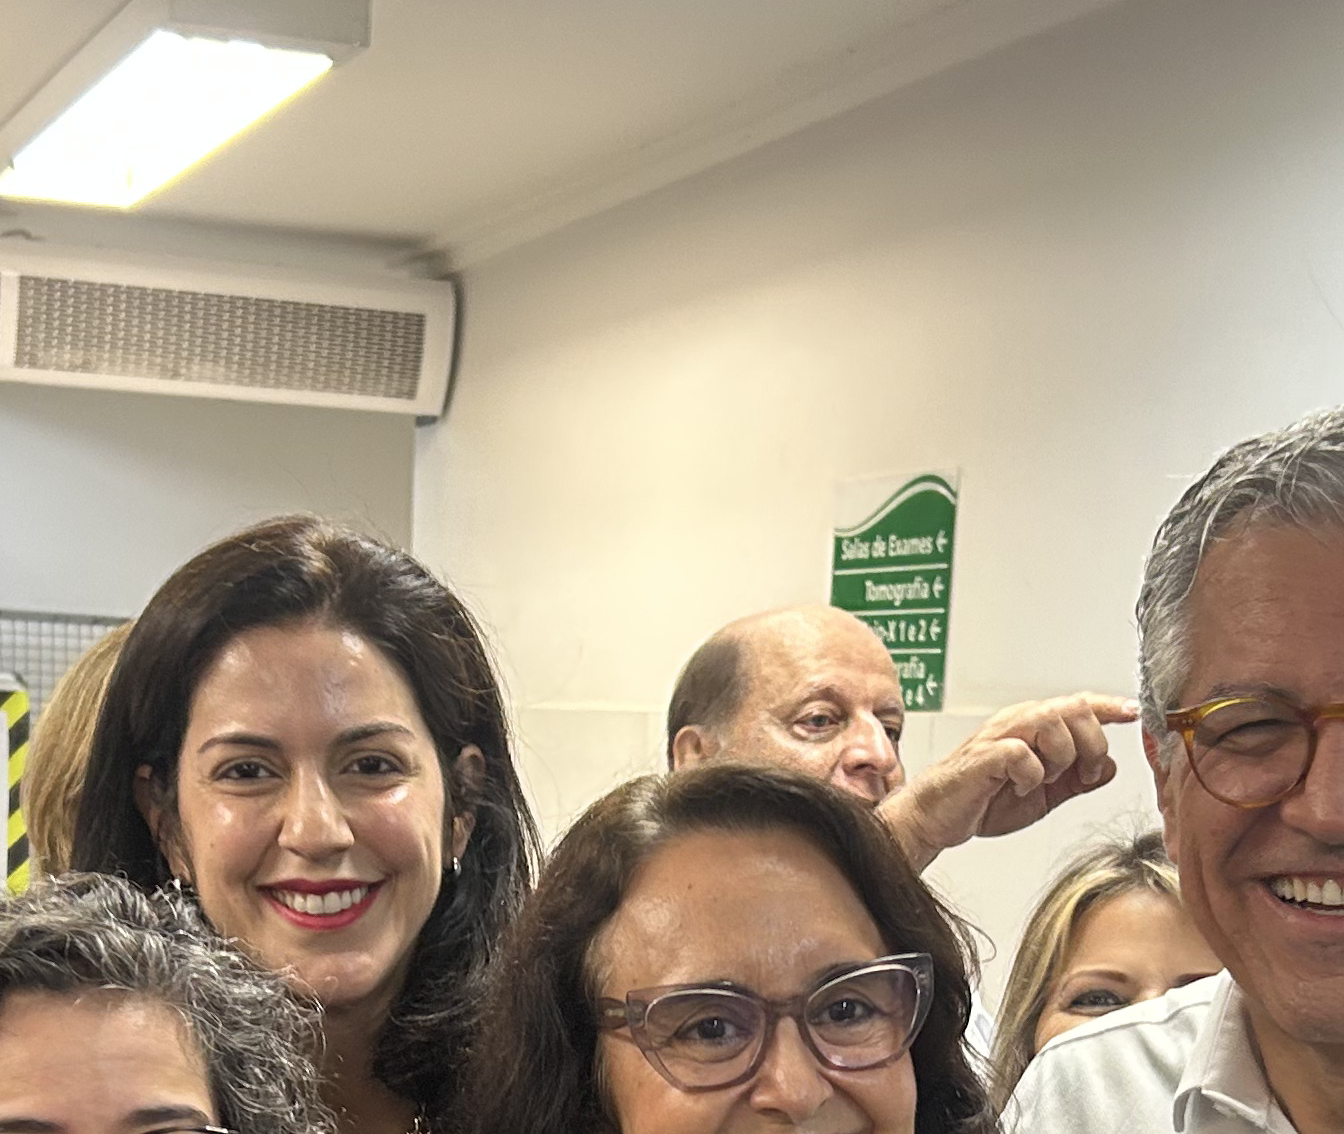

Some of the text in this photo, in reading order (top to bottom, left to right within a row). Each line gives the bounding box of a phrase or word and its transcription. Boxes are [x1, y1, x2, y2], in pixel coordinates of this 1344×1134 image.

[841, 534, 933, 560] Salas de Exames
[865, 576, 930, 606] Tomografia
[918, 619, 927, 642] 2
